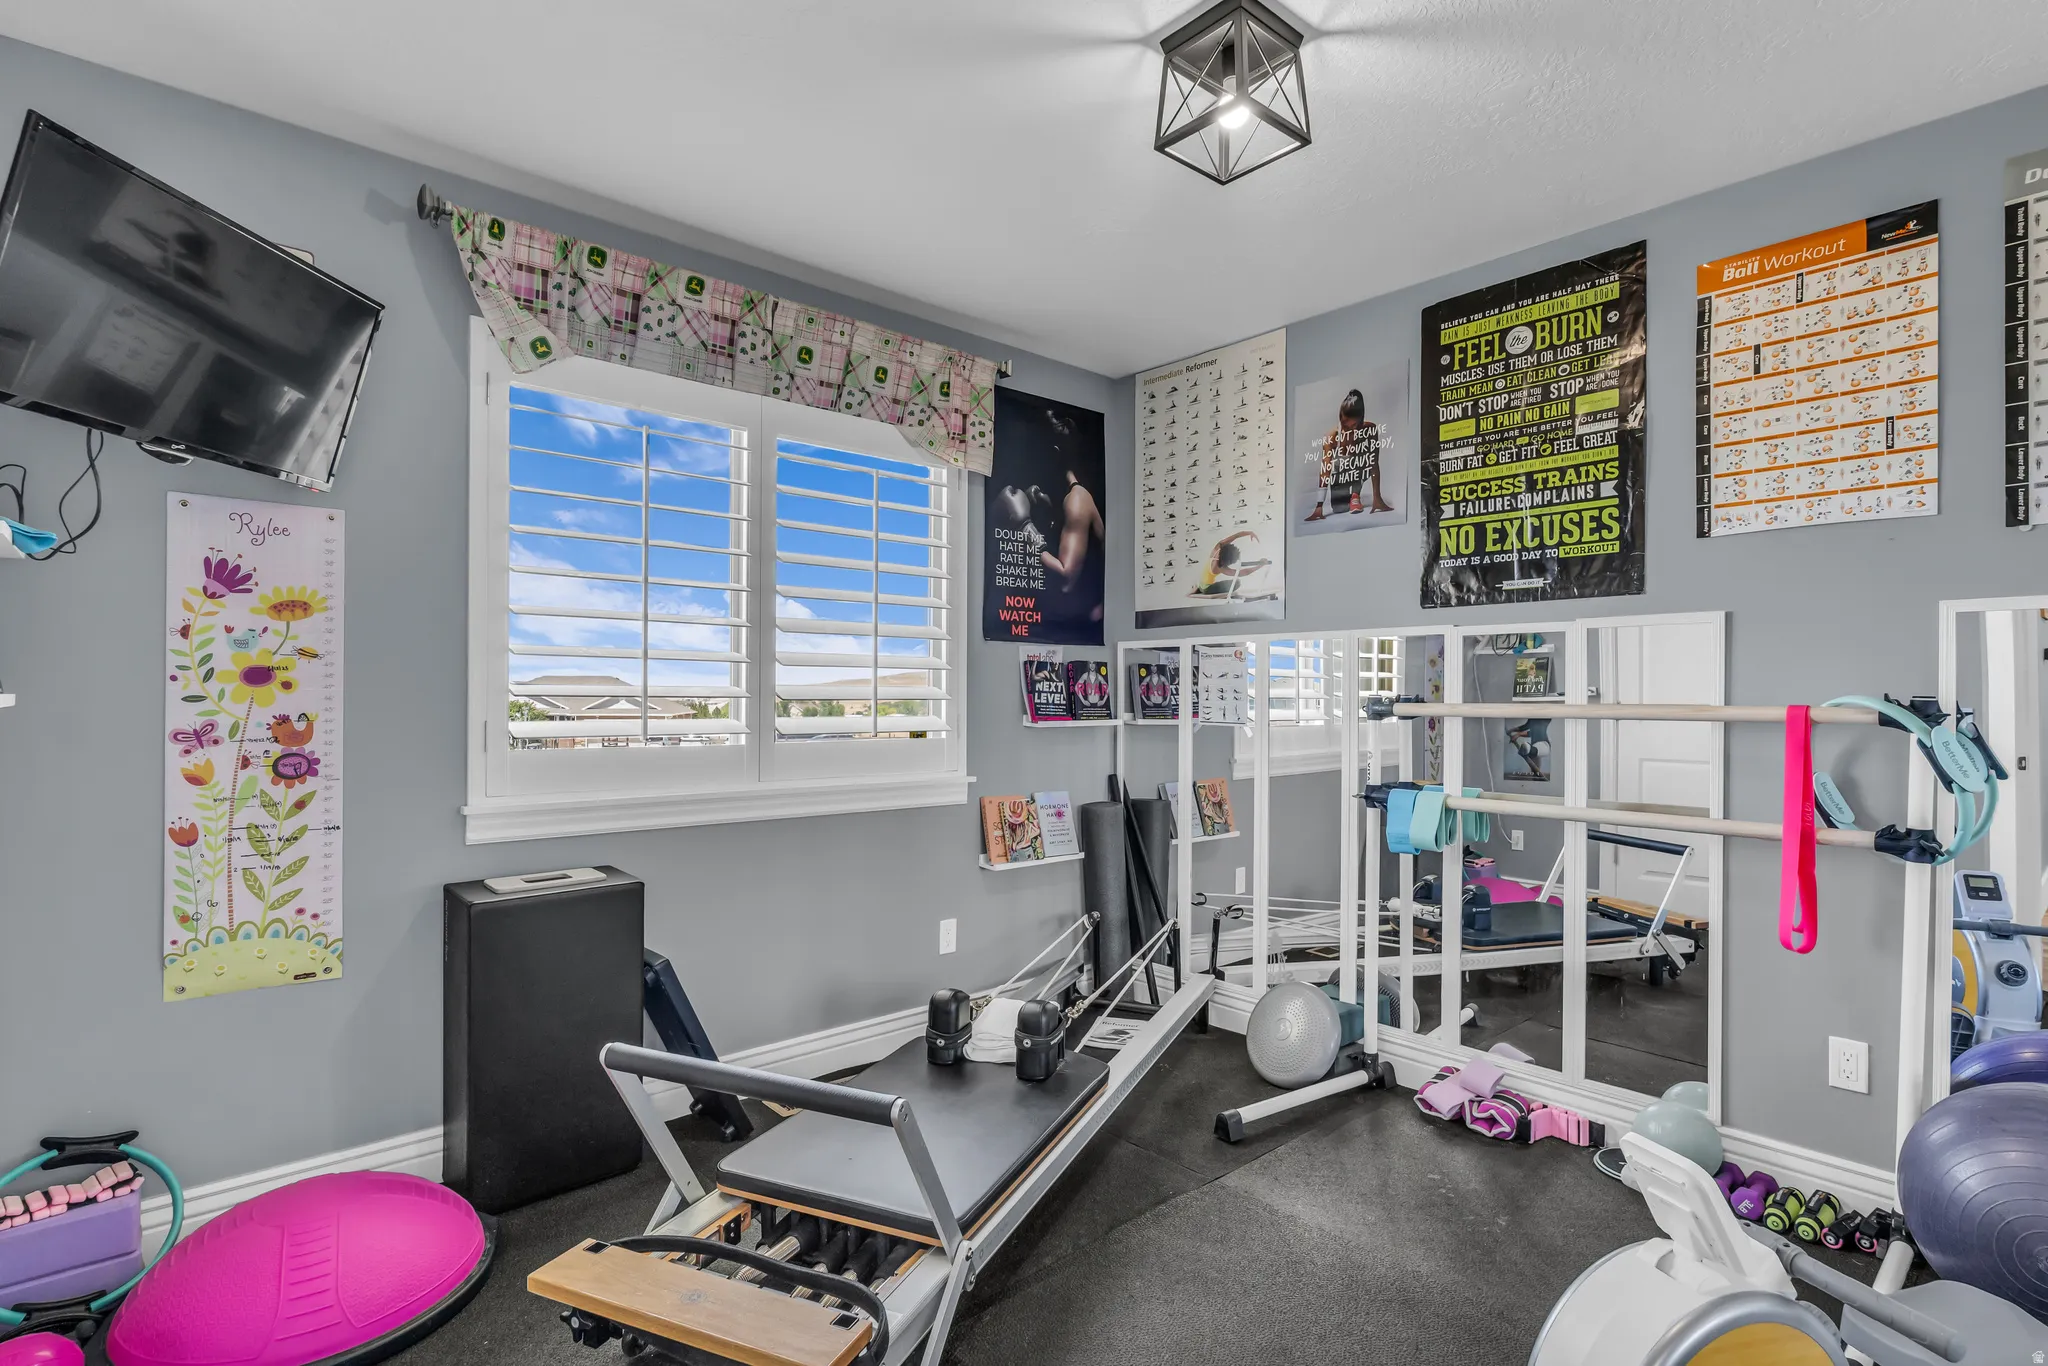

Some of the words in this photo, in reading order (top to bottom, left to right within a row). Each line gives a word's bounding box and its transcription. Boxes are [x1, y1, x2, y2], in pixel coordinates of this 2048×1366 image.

[1722, 261, 1759, 282] Ball
[1763, 238, 1846, 271] Workout
[1724, 256, 1761, 269] STABILITY
[1441, 317, 1467, 329] BELIEVE
[1470, 312, 1483, 322] YOU
[1485, 307, 1499, 317] CAN
[1502, 303, 1515, 312] AND
[1518, 298, 1532, 307] YOU
[1535, 293, 1549, 302] ARE
[1553, 287, 1572, 298] HALF
[1575, 281, 1591, 291] WAY
[1595, 273, 1620, 287] THERE
[1444, 328, 1459, 342] PAIN
[1463, 325, 1470, 336] IS
[1474, 319, 1491, 334] JUST
[1496, 308, 1533, 328] WEAKNESS
[1538, 298, 1570, 316] LEAVING
[1576, 292, 1588, 306] THE
[1594, 285, 1615, 301] BODY
[1453, 333, 1506, 371] FEEL
[1510, 334, 1528, 347] the
[1535, 305, 1603, 350] BURN
[1441, 367, 1485, 387] MUSCLES:
[1488, 361, 1506, 376] USE
[1508, 353, 1537, 371] THEM
[1541, 350, 1554, 363] OR
[1557, 343, 1583, 360] LOSE
[1586, 334, 1618, 353] THEM
[1572, 358, 1590, 373] GET
[1143, 368, 1184, 386] Intermediate
[1185, 358, 1218, 373] Reformer
[1507, 374, 1524, 387] EAT
[1527, 366, 1557, 383] CLEAN
[1586, 372, 1605, 383] WHEN
[1607, 369, 1620, 379] YOU
[1441, 387, 1466, 403] TRAIN
[1469, 381, 1493, 396] MEAN
[1510, 388, 1528, 400] WHEN
[1530, 386, 1542, 396] YOU
[1549, 378, 1585, 399] STOP
[1586, 382, 1597, 391] ARE
[1440, 401, 1474, 422] DON'T
[1478, 394, 1509, 414] STOP
[1510, 397, 1521, 407] ARE
[1480, 417, 1494, 431] NO
[1497, 411, 1521, 428] PAIN
[1525, 407, 1540, 422] NO
[1543, 401, 1570, 419] GAIN
[1311, 435, 1333, 448] WORK
[1335, 429, 1352, 442] OUT
[1353, 423, 1387, 440] BECAUSE
[1440, 442, 1454, 450] THE
[1457, 437, 1482, 447] FITTER
[1485, 433, 1501, 442] YOU
[1503, 429, 1520, 438] ARE
[1522, 426, 1538, 434] THE
[1541, 420, 1572, 431] BETTER
[1597, 411, 1619, 420] FEEL
[1531, 433, 1545, 442] GO
[1547, 428, 1573, 439] HOME
[1304, 451, 1319, 464] YOU
[1322, 446, 1343, 460] LOVE
[1345, 441, 1367, 457] YOUR
[1370, 436, 1395, 451] BODY,
[1477, 444, 1490, 452] GO
[1492, 440, 1514, 449] HARD
[1554, 437, 1580, 454] FEEL
[1583, 430, 1618, 449] GREAT
[1320, 460, 1337, 475] NOT
[1339, 452, 1375, 470] BECAUSE
[1440, 458, 1465, 474] BURN
[1467, 455, 1484, 469] FAT
[1499, 448, 1518, 463] GET
[1521, 445, 1538, 459] FIT
[1320, 473, 1336, 487] YOU
[1338, 469, 1360, 484] HATE
[1361, 466, 1376, 480] IT.
[1440, 475, 1526, 504] SUCCESS
[1533, 461, 1620, 490] TRAINS
[1460, 496, 1511, 516] FAILURE
[1517, 484, 1594, 508] COMPLAINS
[229, 512, 291, 547] Rylee
[994, 527, 1029, 543] DOUBT
[1030, 532, 1047, 545] ME.
[1440, 525, 1475, 557] NO
[1485, 507, 1620, 552] EXCUSES
[999, 540, 1024, 554] HATE
[1026, 544, 1043, 556] ME.
[1439, 557, 1468, 568] TODAY
[1471, 556, 1480, 565] IS
[1483, 555, 1490, 564] A
[1493, 552, 1519, 562] GOOD
[1522, 550, 1542, 560] DAY
[1545, 548, 1558, 557] TO
[1563, 543, 1616, 555] WORKOUT
[1000, 552, 1024, 566] RATE
[1026, 555, 1042, 567] ME.
[995, 564, 1028, 578] SHAKE
[1030, 567, 1046, 579] ME.
[995, 576, 1028, 589] BREAK
[1030, 578, 1046, 590] ME.
[1005, 595, 1035, 609] NOW
[999, 608, 1041, 623] WATCH
[1011, 624, 1029, 636] ME
[1035, 680, 1063, 693] NEXT
[1076, 682, 1109, 696] ROAR
[1034, 692, 1067, 705] LEVEL
[1942, 740, 1970, 779] BetterMe
[1040, 803, 1069, 811] HORMONE
[1820, 781, 1845, 815] BetterMe
